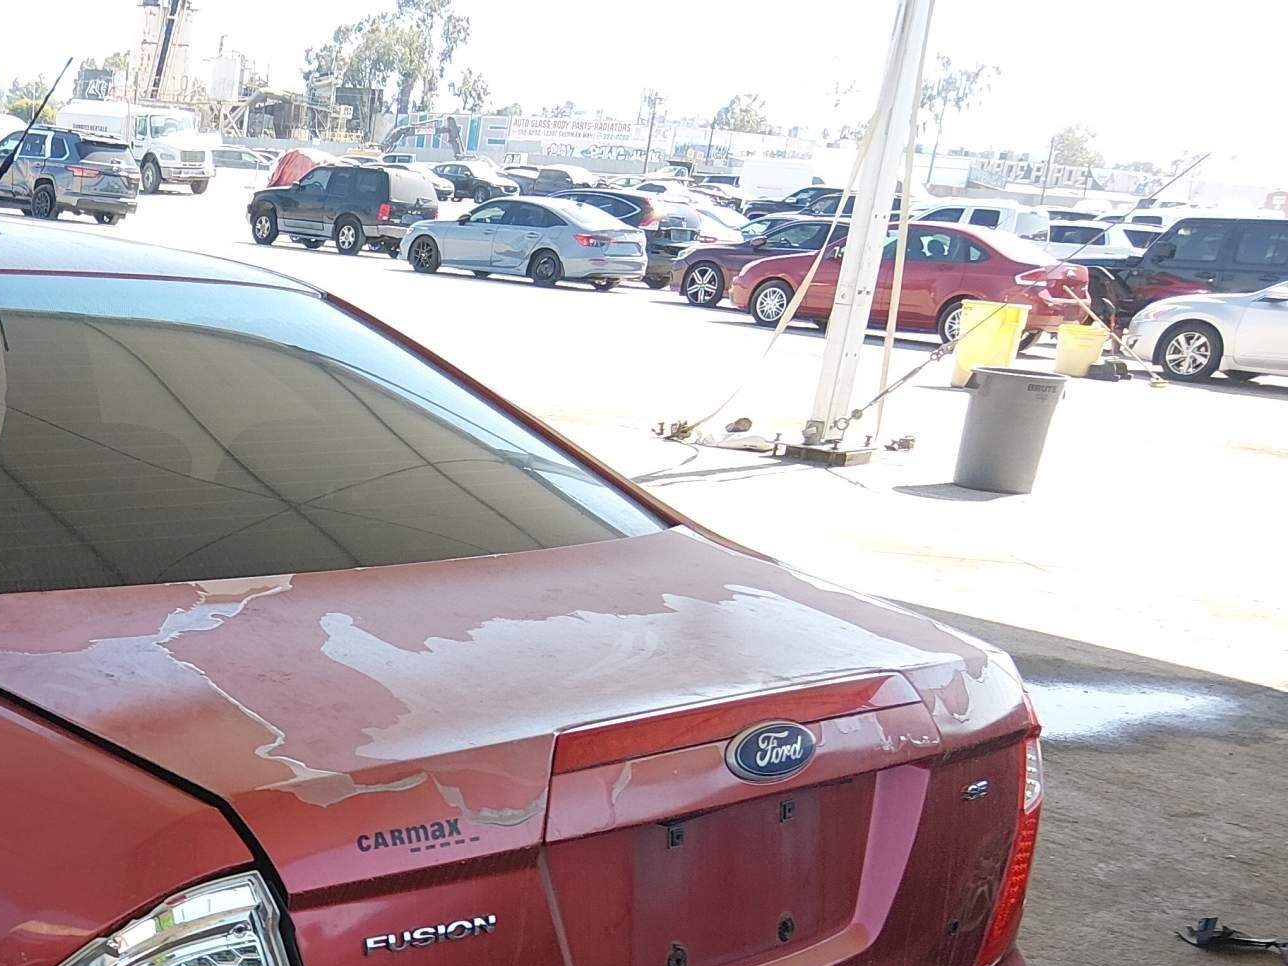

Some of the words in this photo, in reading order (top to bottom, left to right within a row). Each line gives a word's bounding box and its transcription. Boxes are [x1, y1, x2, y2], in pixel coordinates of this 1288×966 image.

[513, 118, 529, 128] AUTO
[756, 730, 804, 767] Ford
[364, 914, 497, 957] FUSION
